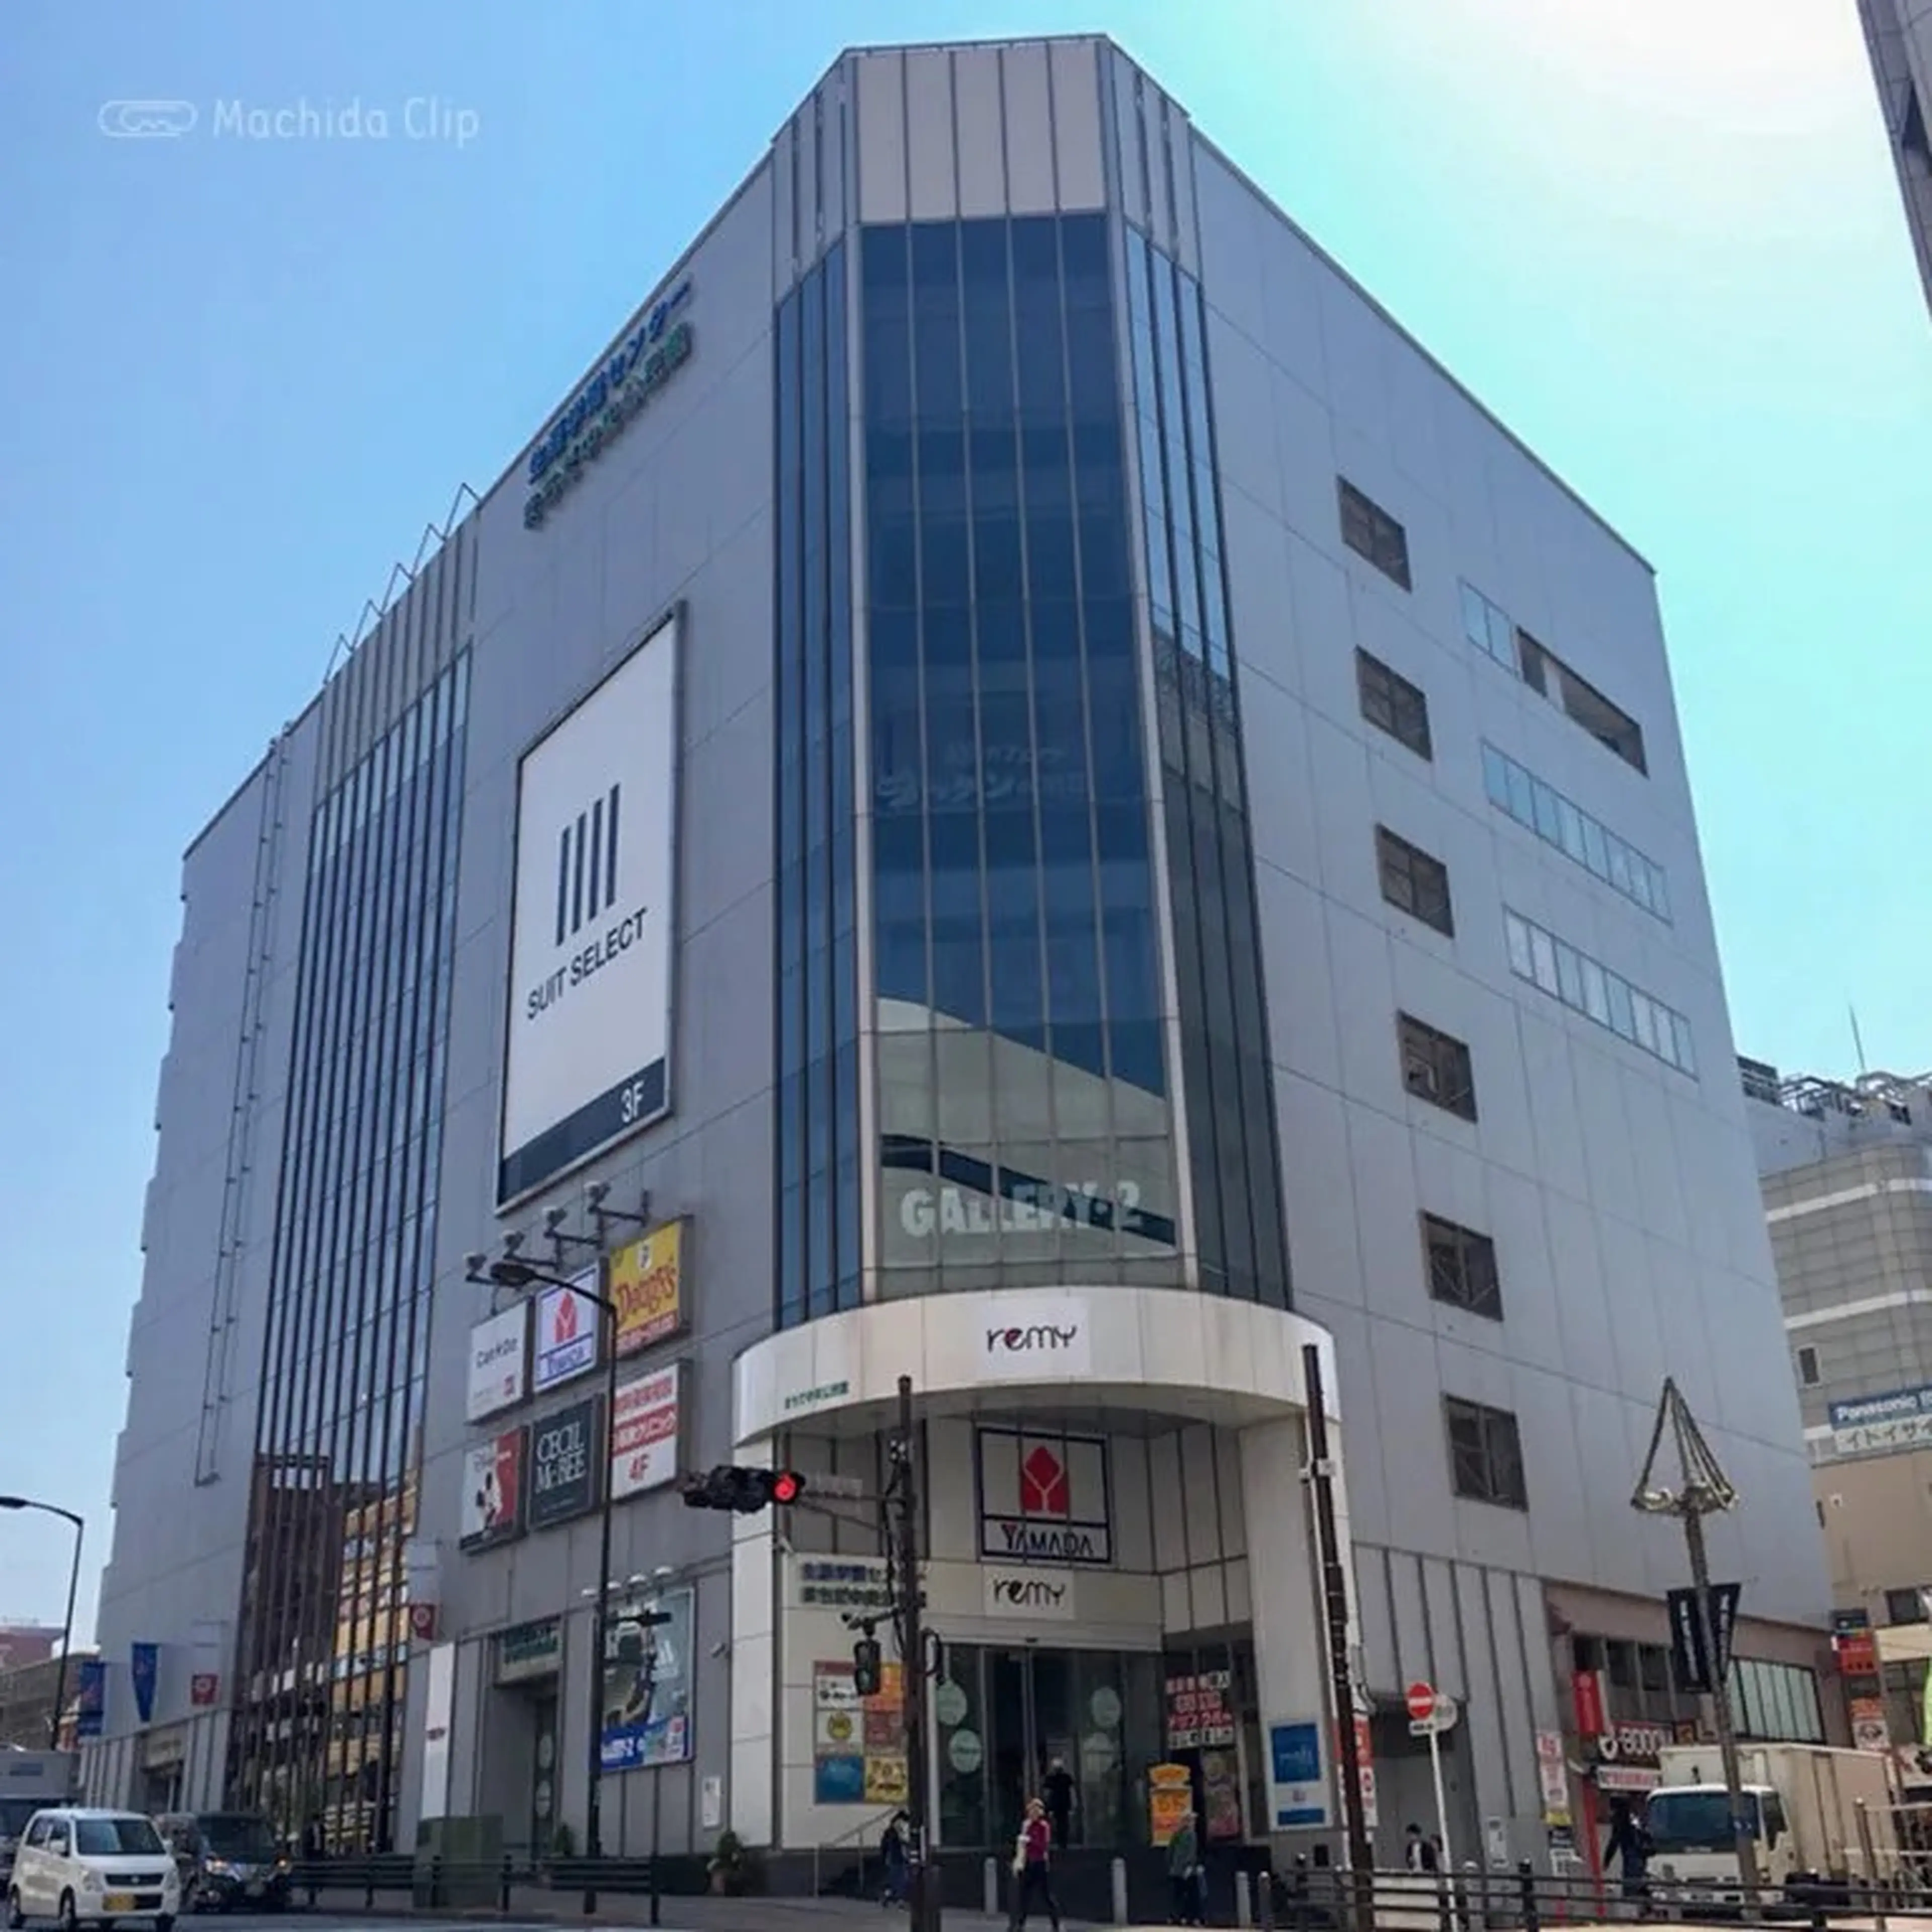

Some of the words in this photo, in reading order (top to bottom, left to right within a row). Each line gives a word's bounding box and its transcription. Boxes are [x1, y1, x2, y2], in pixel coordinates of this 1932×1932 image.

[527, 967, 567, 1020] SUIT
[571, 907, 647, 987] SELECT
[621, 1081, 645, 1123] 3F
[986, 1324, 1077, 1353] remy
[1001, 1522, 1094, 1559] YAMADA
[993, 1579, 1066, 1606] remy
